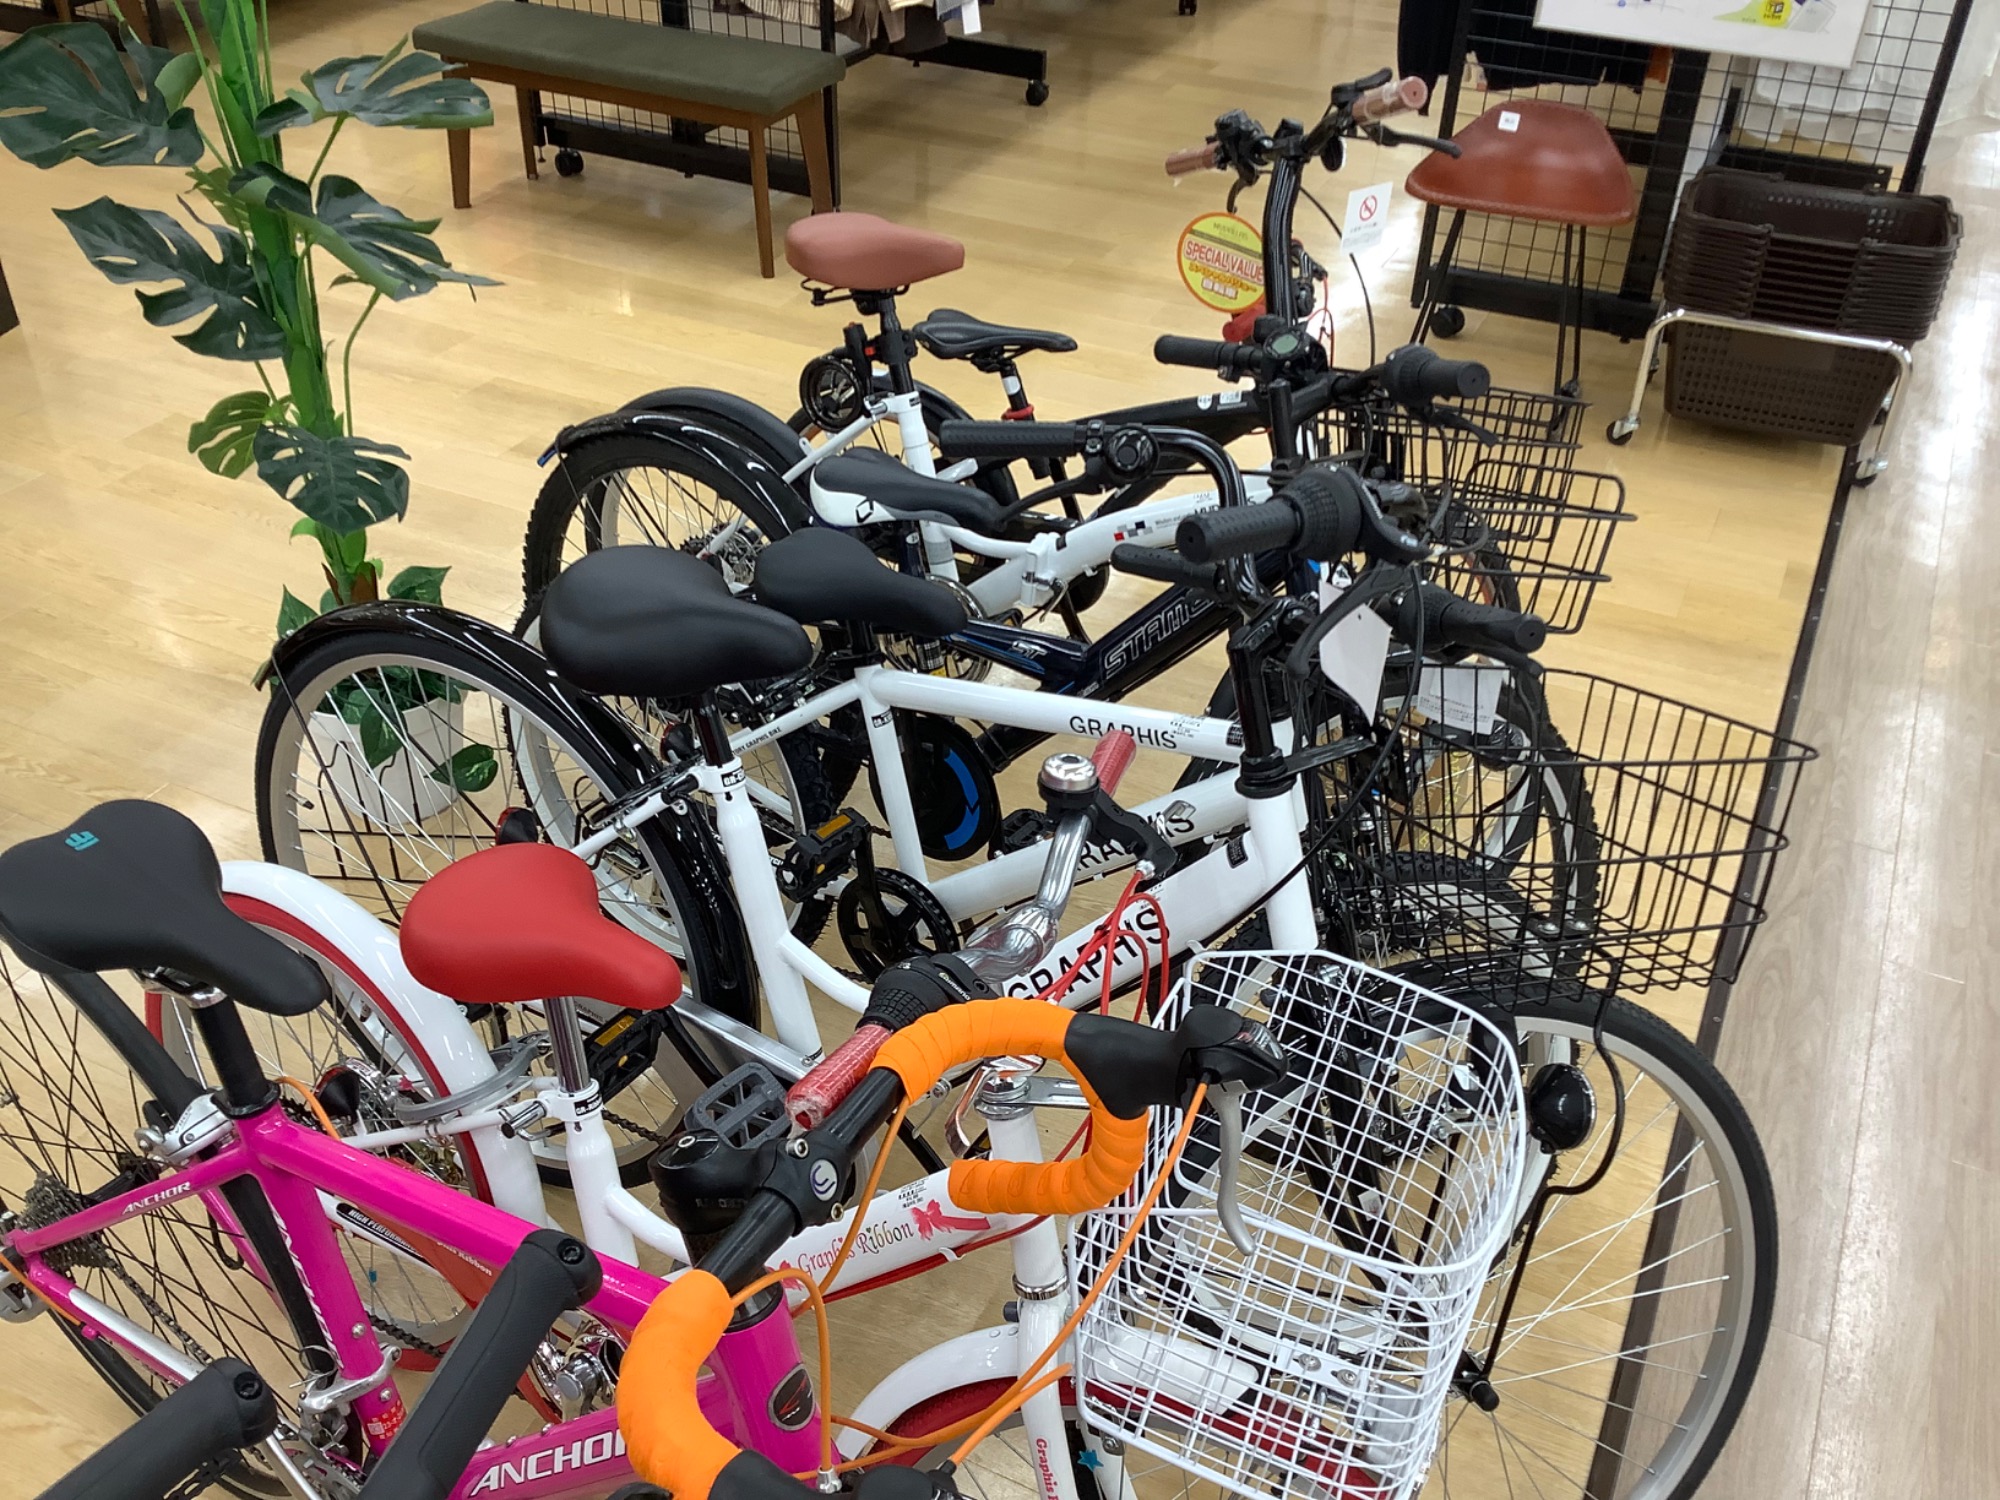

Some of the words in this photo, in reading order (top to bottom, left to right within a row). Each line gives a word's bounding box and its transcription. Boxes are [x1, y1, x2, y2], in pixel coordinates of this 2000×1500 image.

[1185, 239, 1229, 272] SPECIAL
[1228, 257, 1264, 284] VALUE
[122, 1181, 191, 1215] ANCHOR
[348, 1209, 370, 1224] HIGH
[856, 1220, 915, 1255] Ribbon
[1036, 1438, 1058, 1493] Graphis
